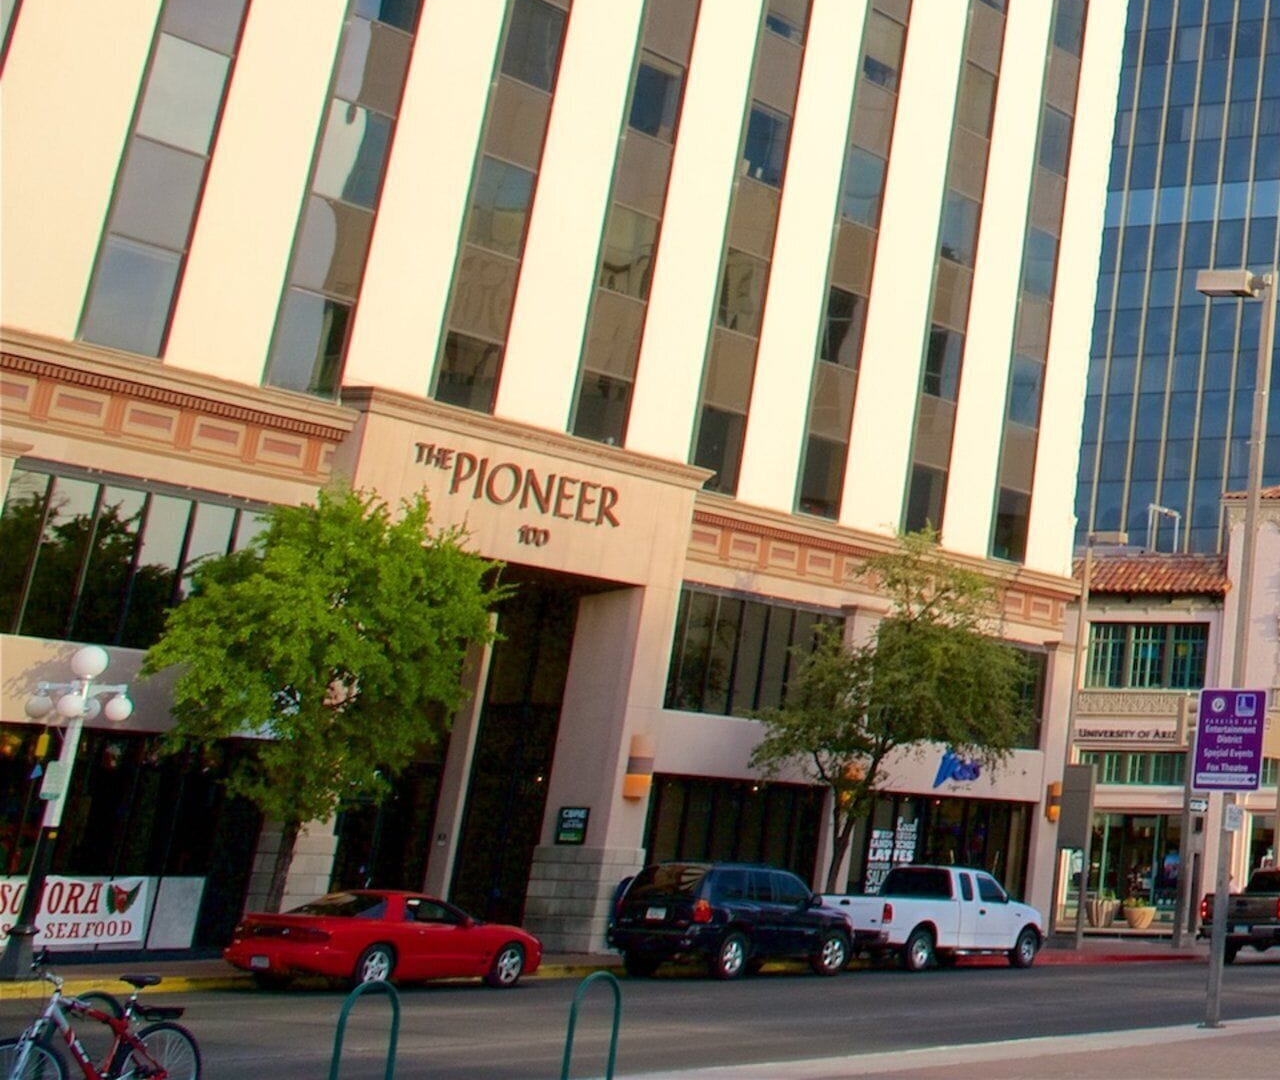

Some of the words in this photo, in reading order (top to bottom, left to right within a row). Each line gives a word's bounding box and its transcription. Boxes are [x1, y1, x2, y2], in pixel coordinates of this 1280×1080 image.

[415, 442, 455, 470] THE
[448, 451, 620, 528] PIONEER
[518, 524, 551, 547] 100
[1078, 728, 1136, 738] UNIVERSITY
[1205, 724, 1256, 734] Entertainment
[1216, 735, 1242, 743] District
[1203, 748, 1228, 758] Special
[1229, 748, 1254, 758] Events
[1206, 762, 1219, 772] Fox
[0, 881, 104, 915] SOORA
[44, 920, 133, 939] SEAFOOD
